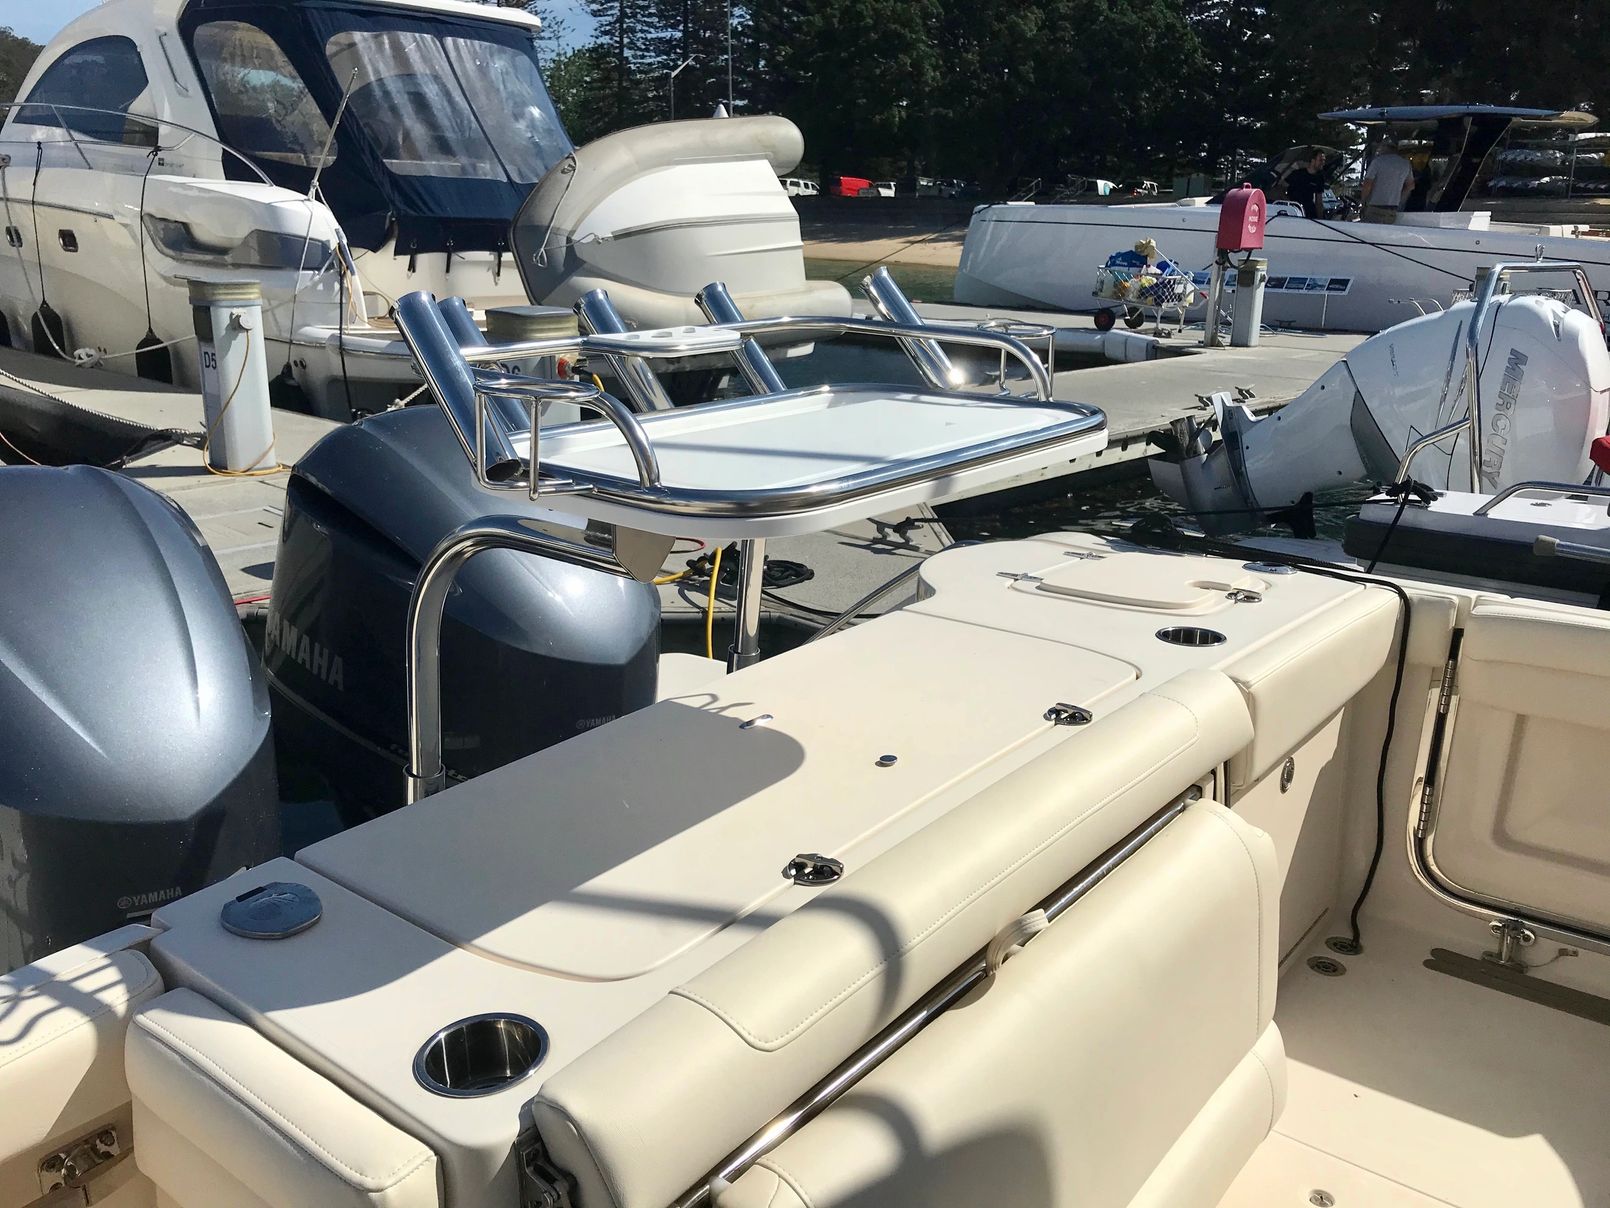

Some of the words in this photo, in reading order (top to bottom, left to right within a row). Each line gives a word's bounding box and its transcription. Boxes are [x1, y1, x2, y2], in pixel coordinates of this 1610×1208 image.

[203, 351, 217, 370] D5
[1481, 347, 1529, 490] MERCURY
[132, 886, 182, 906] YAMAHA
